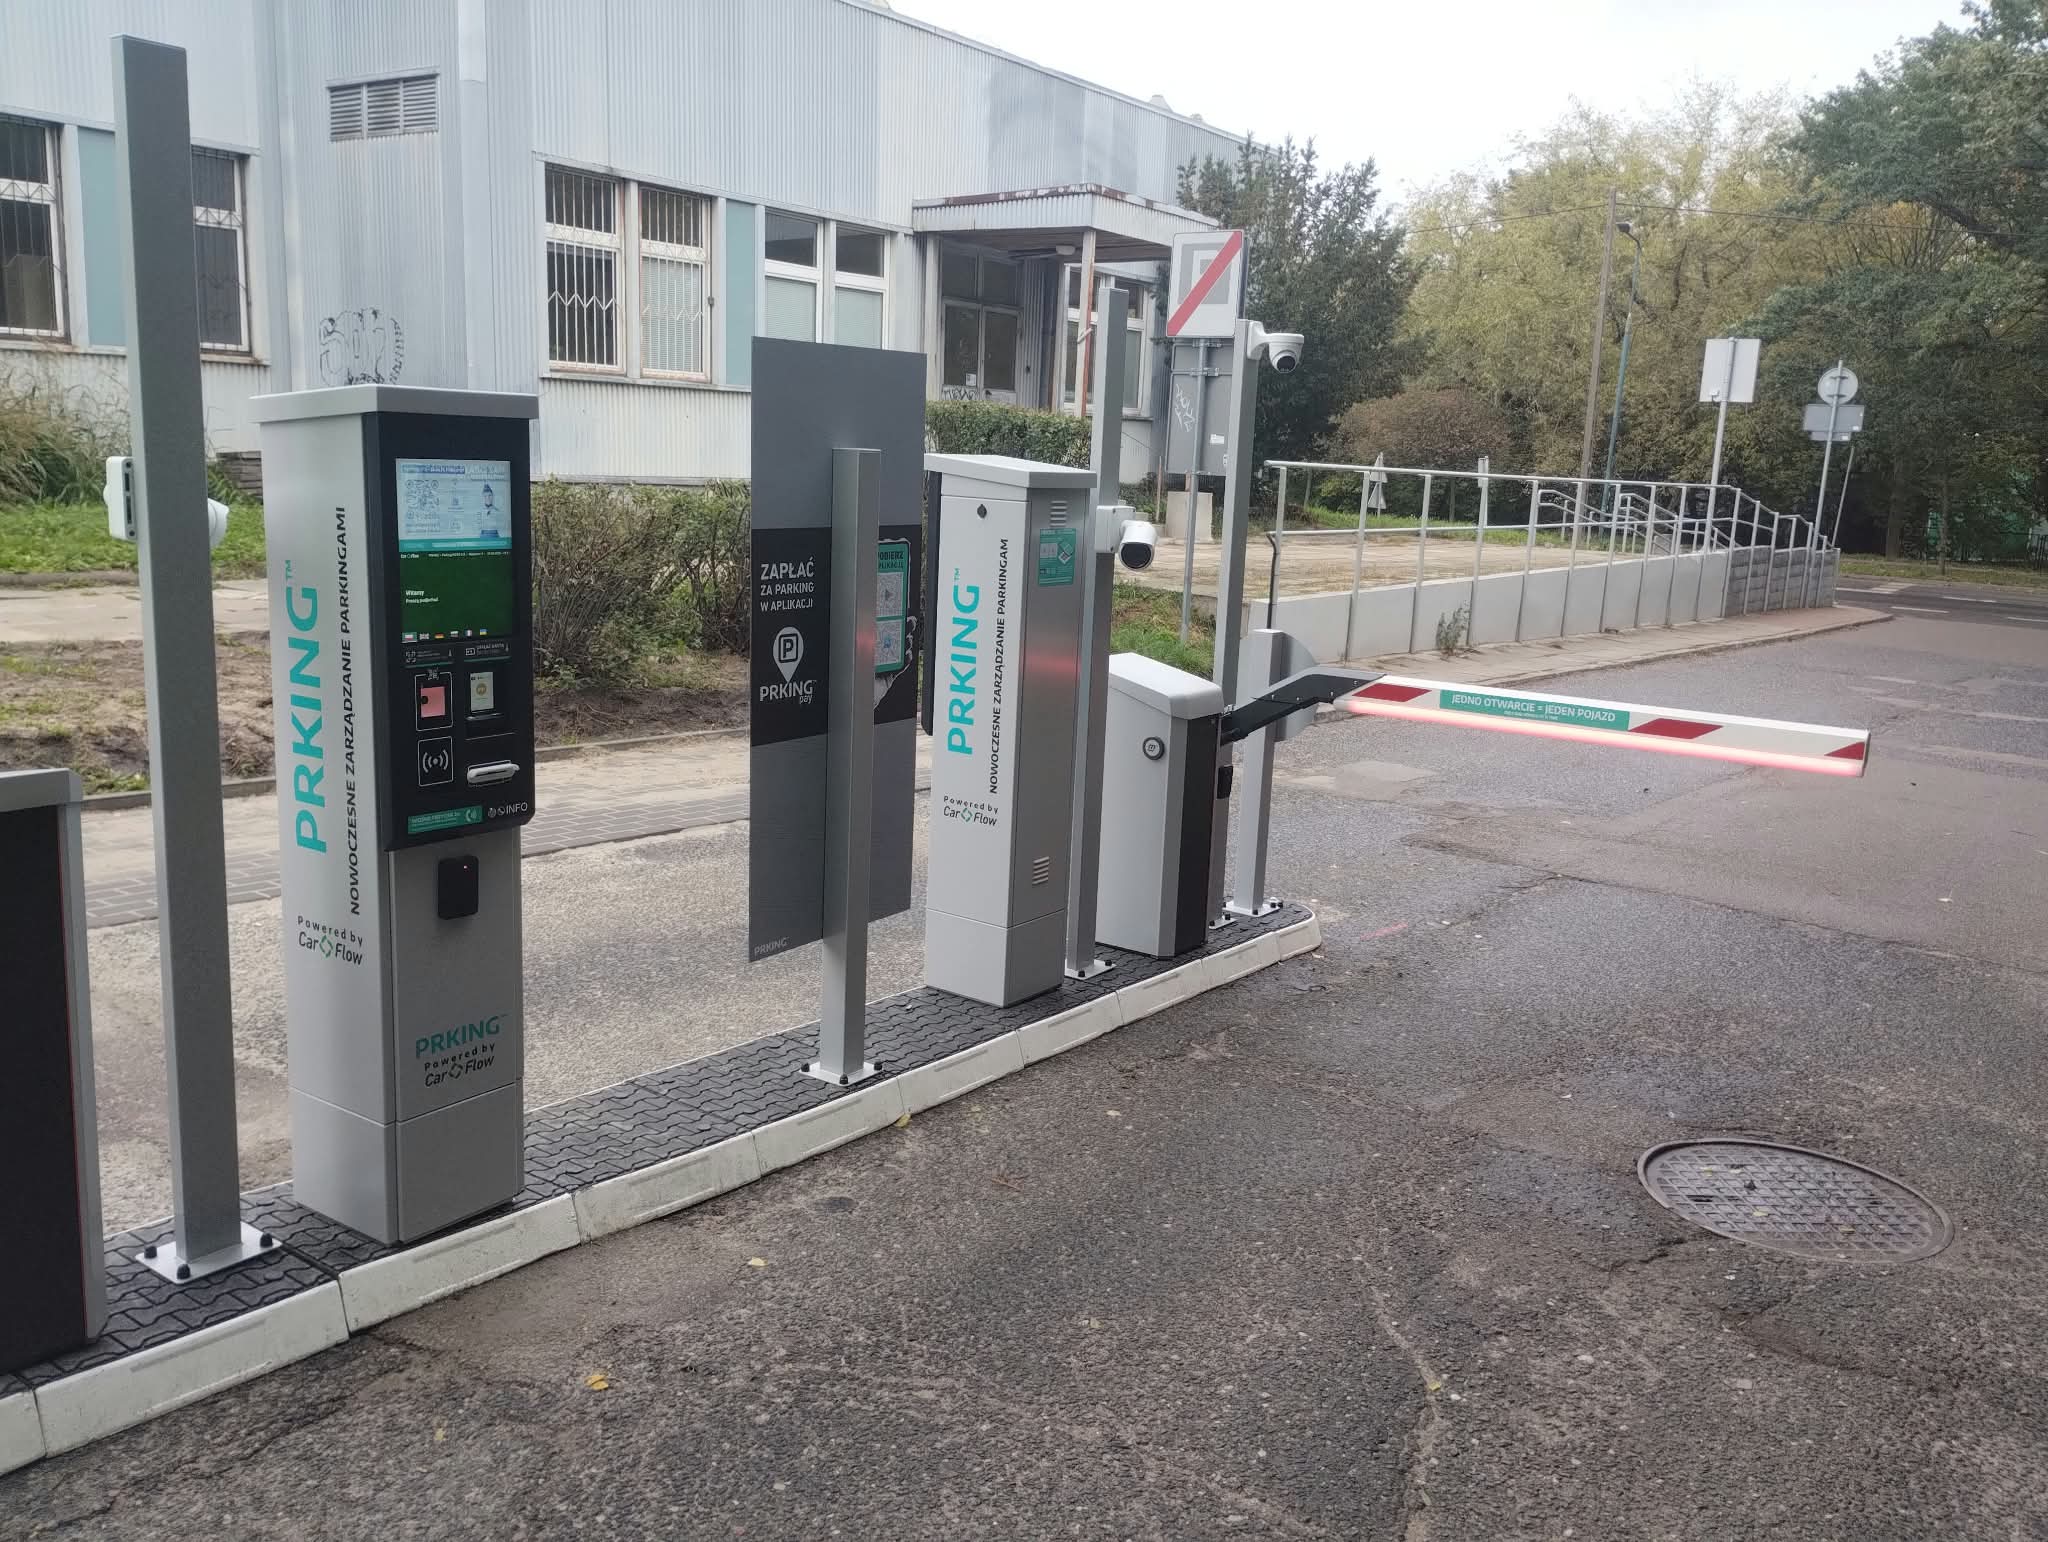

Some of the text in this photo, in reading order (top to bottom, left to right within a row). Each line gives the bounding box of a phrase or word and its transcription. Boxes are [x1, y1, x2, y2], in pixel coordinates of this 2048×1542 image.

[877, 551, 904, 561] OBIERZ
[760, 556, 815, 581] ZAPŁAĆ
[760, 581, 815, 597] ZA PARKING
[760, 598, 813, 613] W APLIKACJI
[947, 585, 979, 755] PRKING
[993, 618, 1006, 704] ZARZĄDZANIE
[759, 680, 814, 702] PRKING
[799, 693, 813, 704] pay
[335, 507, 361, 916] NOWOCZESNE ZARZĄDZANIE PARKINGAMI
[1451, 694, 1482, 706] JEDNO
[1483, 697, 1535, 713] OTWARCIE
[1544, 704, 1576, 718] JEDEN
[1577, 708, 1617, 723] POJAZD
[286, 586, 327, 854] PRKING
[989, 707, 1001, 795] NOWOCZESNE
[506, 801, 529, 816] INFO
[987, 804, 999, 815] by
[350, 930, 363, 948] by
[415, 1015, 500, 1060] PRKING
[481, 1042, 496, 1054] by
